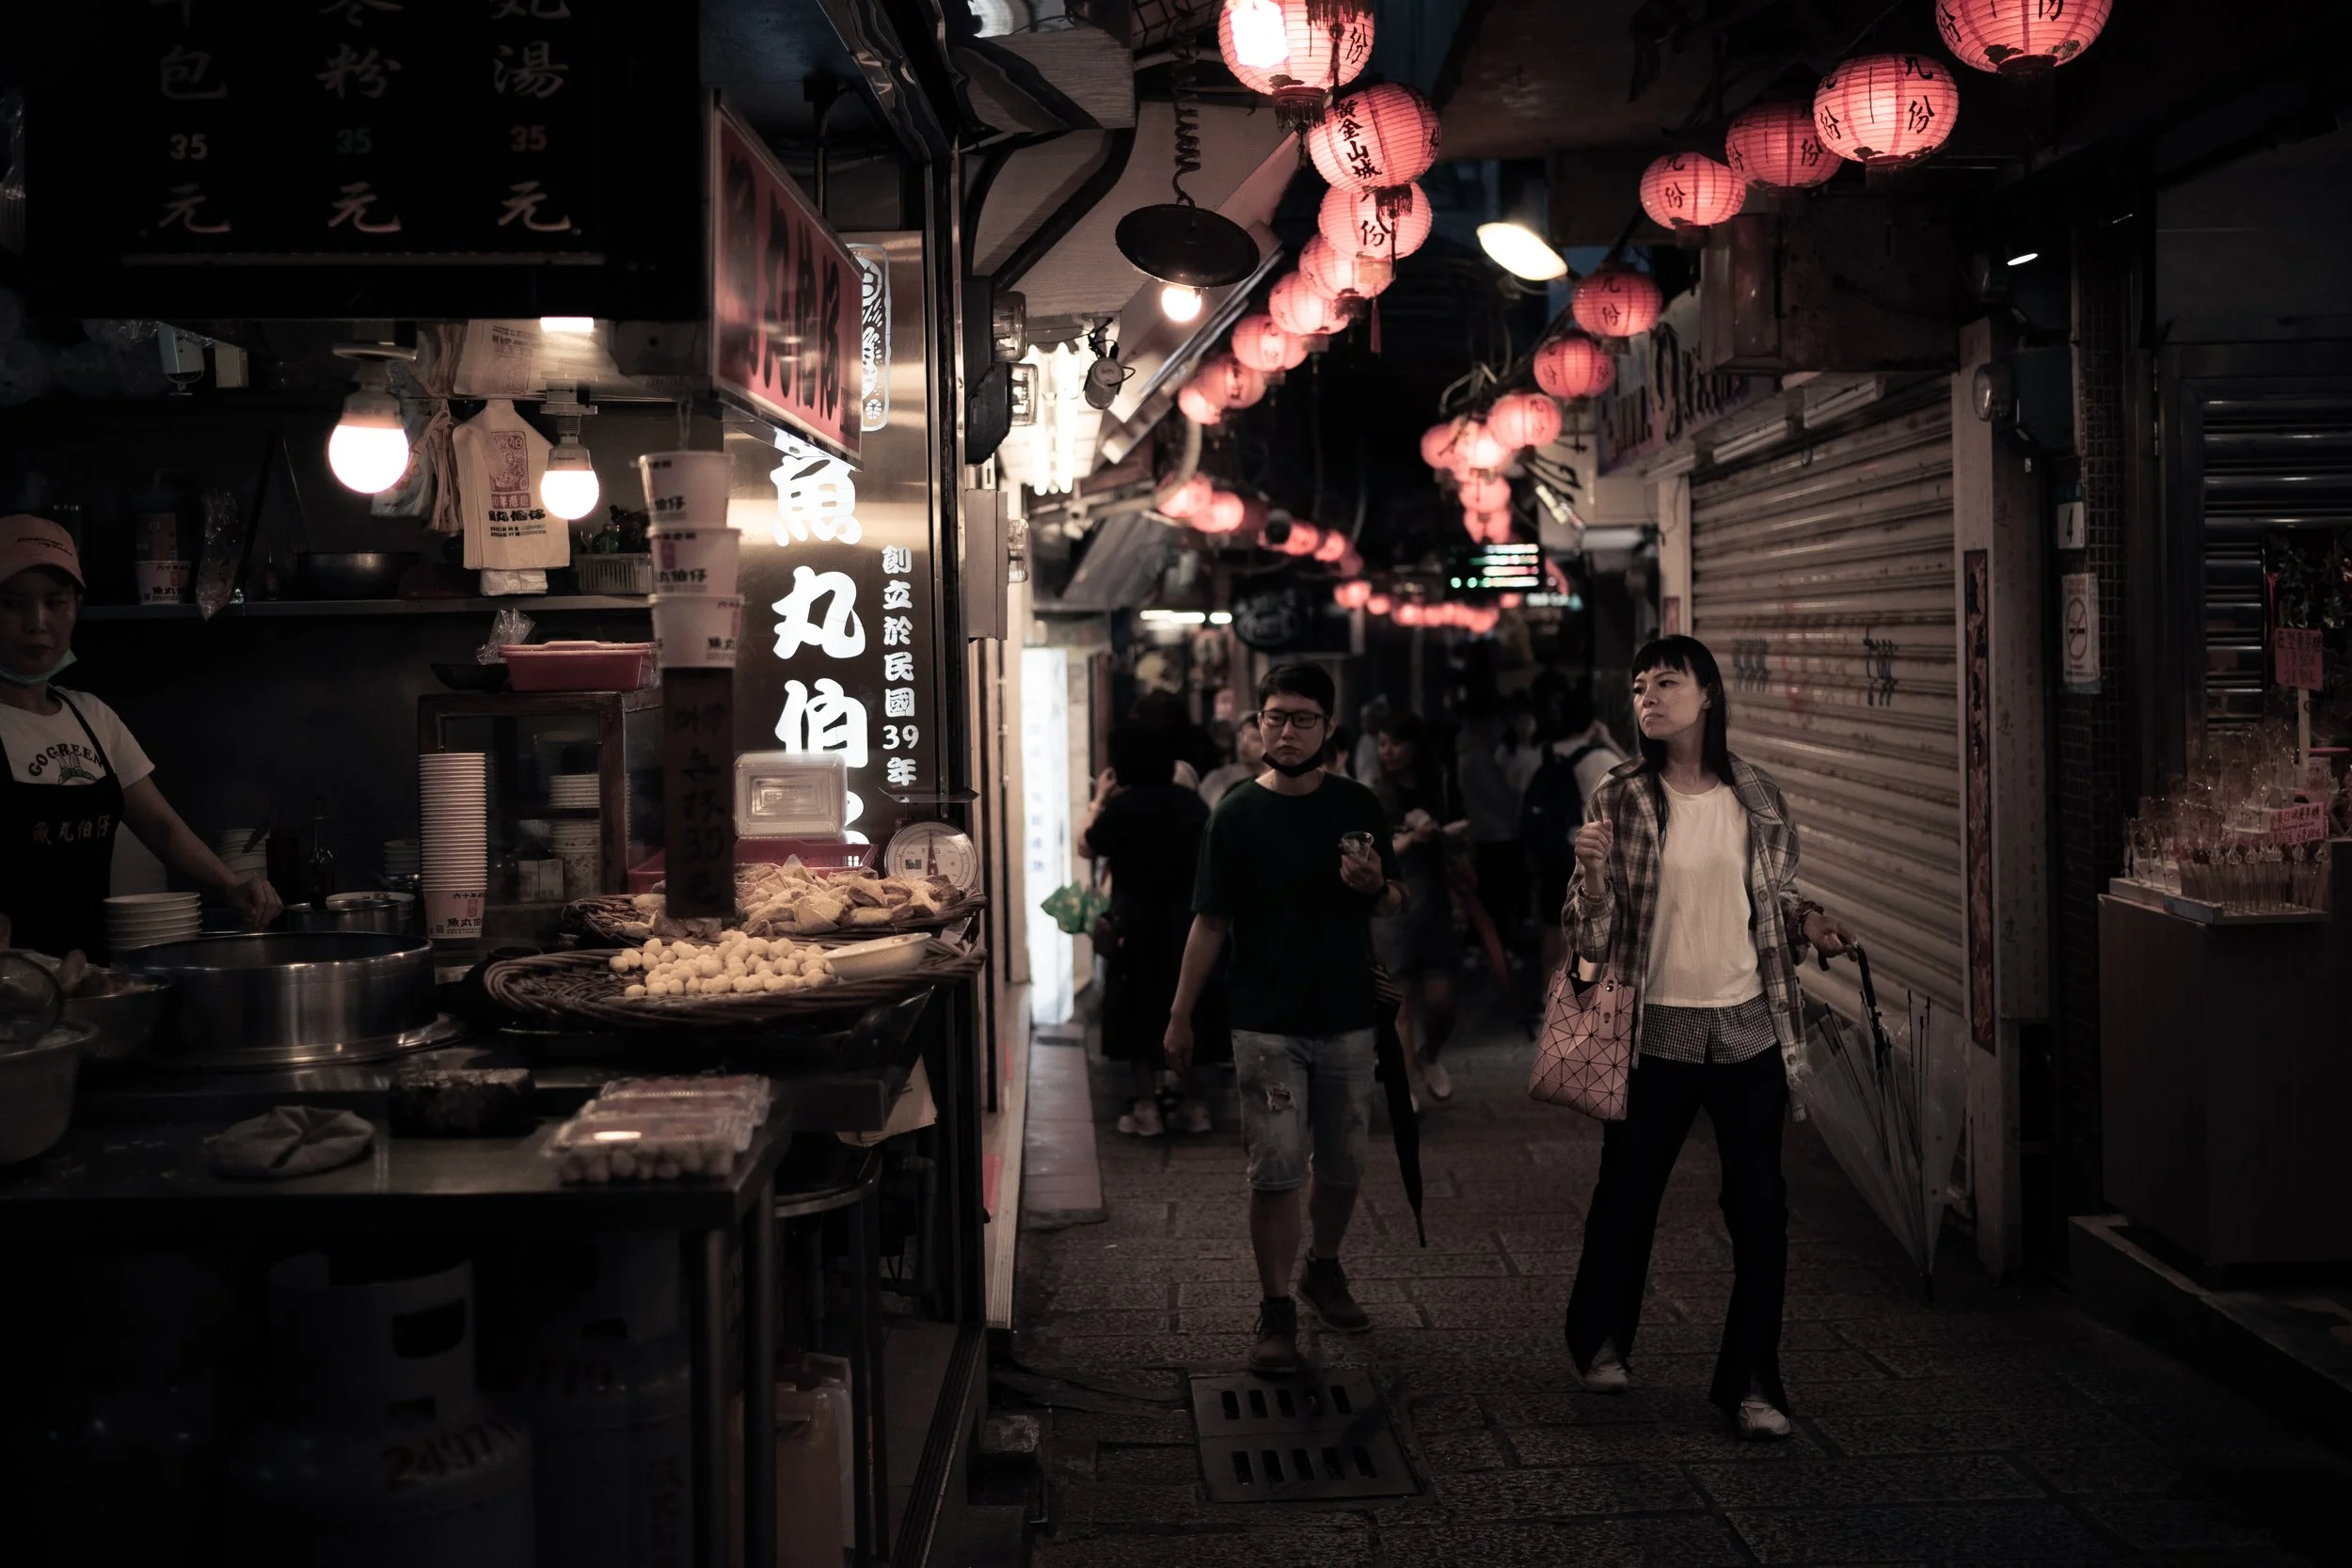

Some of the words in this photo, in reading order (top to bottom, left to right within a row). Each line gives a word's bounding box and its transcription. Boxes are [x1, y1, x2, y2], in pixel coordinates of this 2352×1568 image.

[1903, 56, 1935, 135] 九份
[770, 454, 870, 845] 魚丸伯
[882, 545, 920, 786] 創立於民國39年
